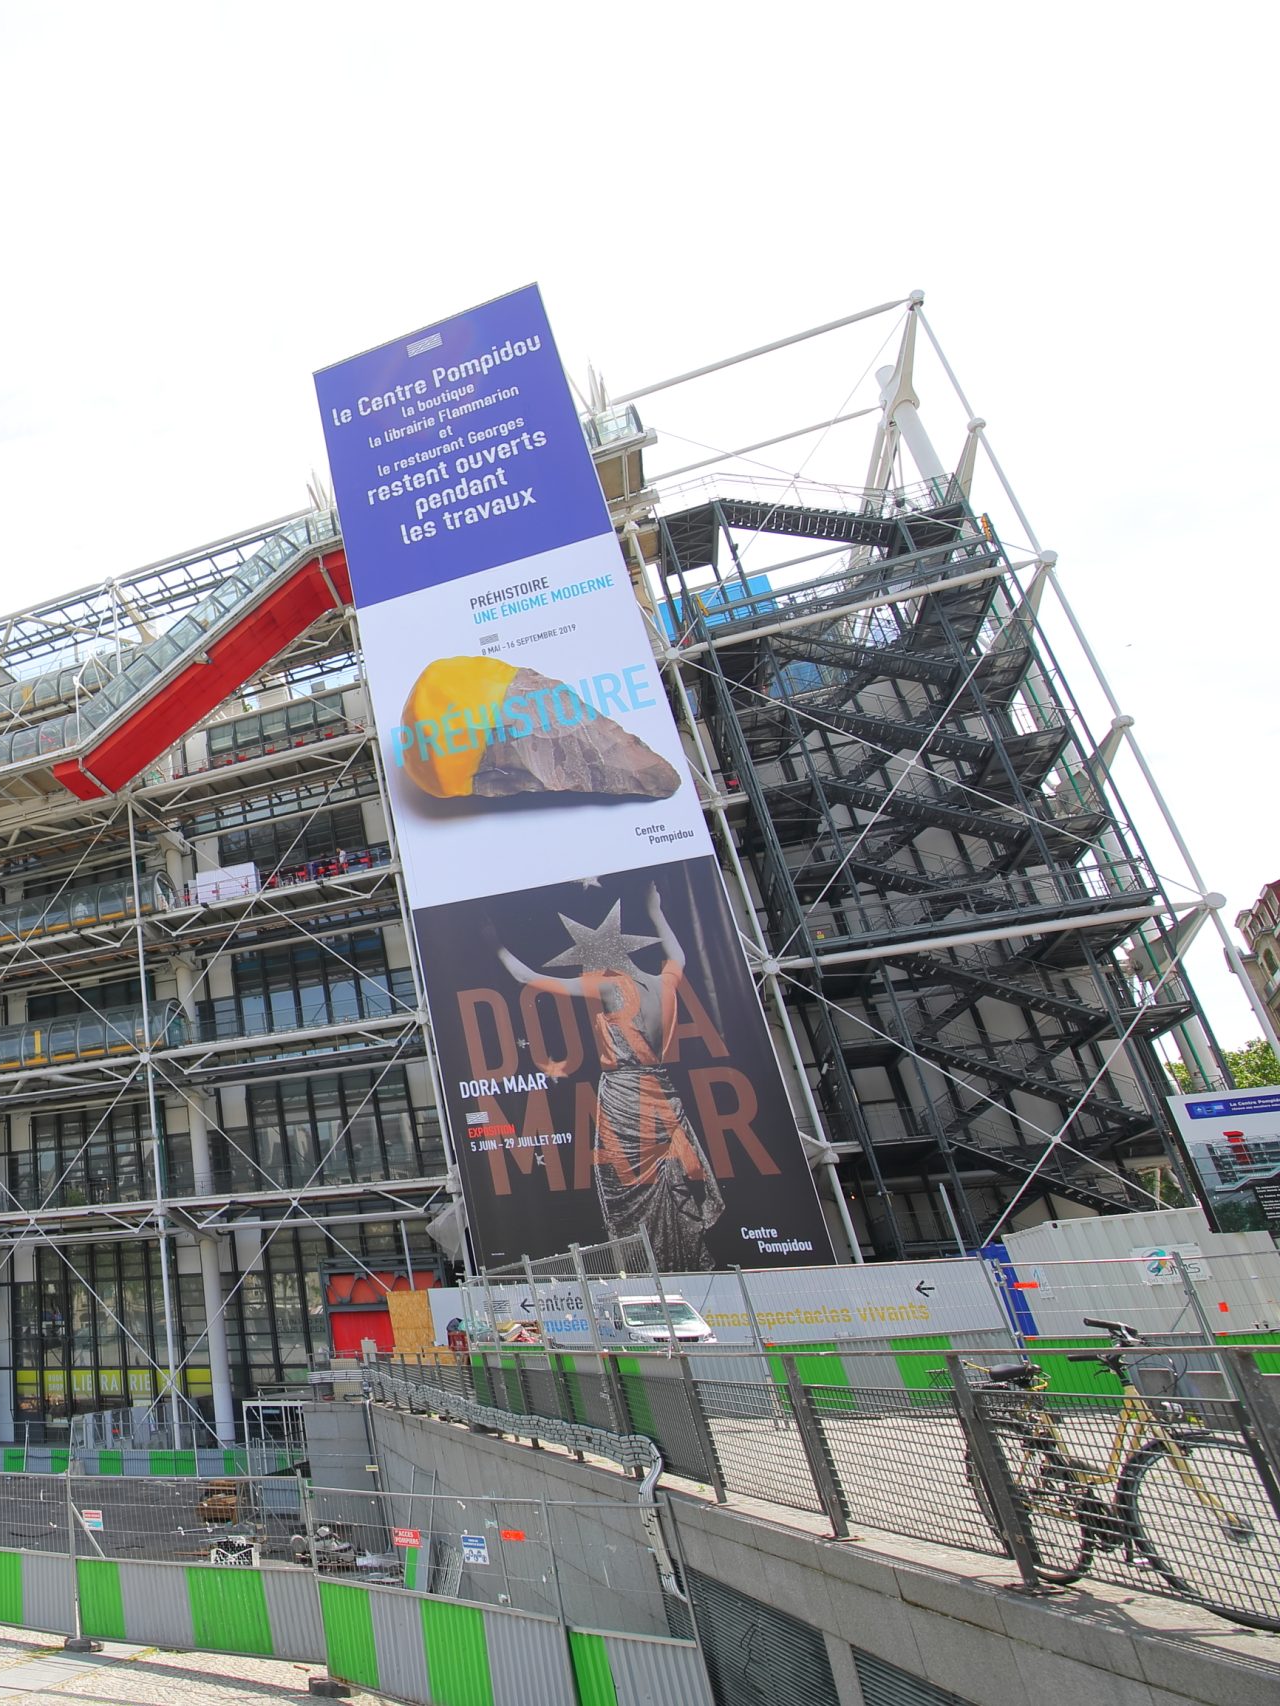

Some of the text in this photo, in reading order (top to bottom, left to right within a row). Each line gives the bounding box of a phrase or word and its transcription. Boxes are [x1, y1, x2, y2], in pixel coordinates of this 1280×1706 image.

[332, 335, 542, 427] le Centre Pompidou
[369, 385, 520, 448] la librairie Flammarion
[401, 382, 475, 418] la boutique
[377, 416, 525, 477] le restaurant Georges
[438, 425, 454, 439] et
[367, 430, 548, 505] restent ouverts
[416, 467, 508, 520] pendant
[400, 486, 537, 545] les travaux
[469, 576, 550, 610] PRÉHISTOIRE
[473, 574, 615, 625] UNE ÉNIGME MODERNE
[481, 648, 487, 656] 8
[488, 645, 501, 654] MAI
[506, 641, 515, 650] 16
[516, 628, 558, 647] SEPTEMBRE
[558, 623, 577, 636] 2019
[390, 663, 657, 768] PRÉHISTOIRE
[635, 824, 666, 837] Centre
[649, 829, 695, 845] Pompidou
[457, 960, 730, 1075] DORA
[459, 1072, 548, 1099] DORA MAAR
[468, 1124, 516, 1138] EXPOSITION
[471, 1142, 477, 1152] 5
[479, 1140, 497, 1151] JUIN
[504, 1138, 514, 1148] 29
[517, 1134, 549, 1147] JUILLET
[551, 1132, 572, 1144] 2019
[474, 1067, 782, 1196] MAAR
[740, 1226, 778, 1240] Centre
[758, 1239, 813, 1254] Pompidou
[538, 1292, 583, 1311] entrée
[757, 1304, 852, 1329] spectacles
[856, 1302, 930, 1323] vivants
[73, 1373, 151, 1391] LIBRARIE
